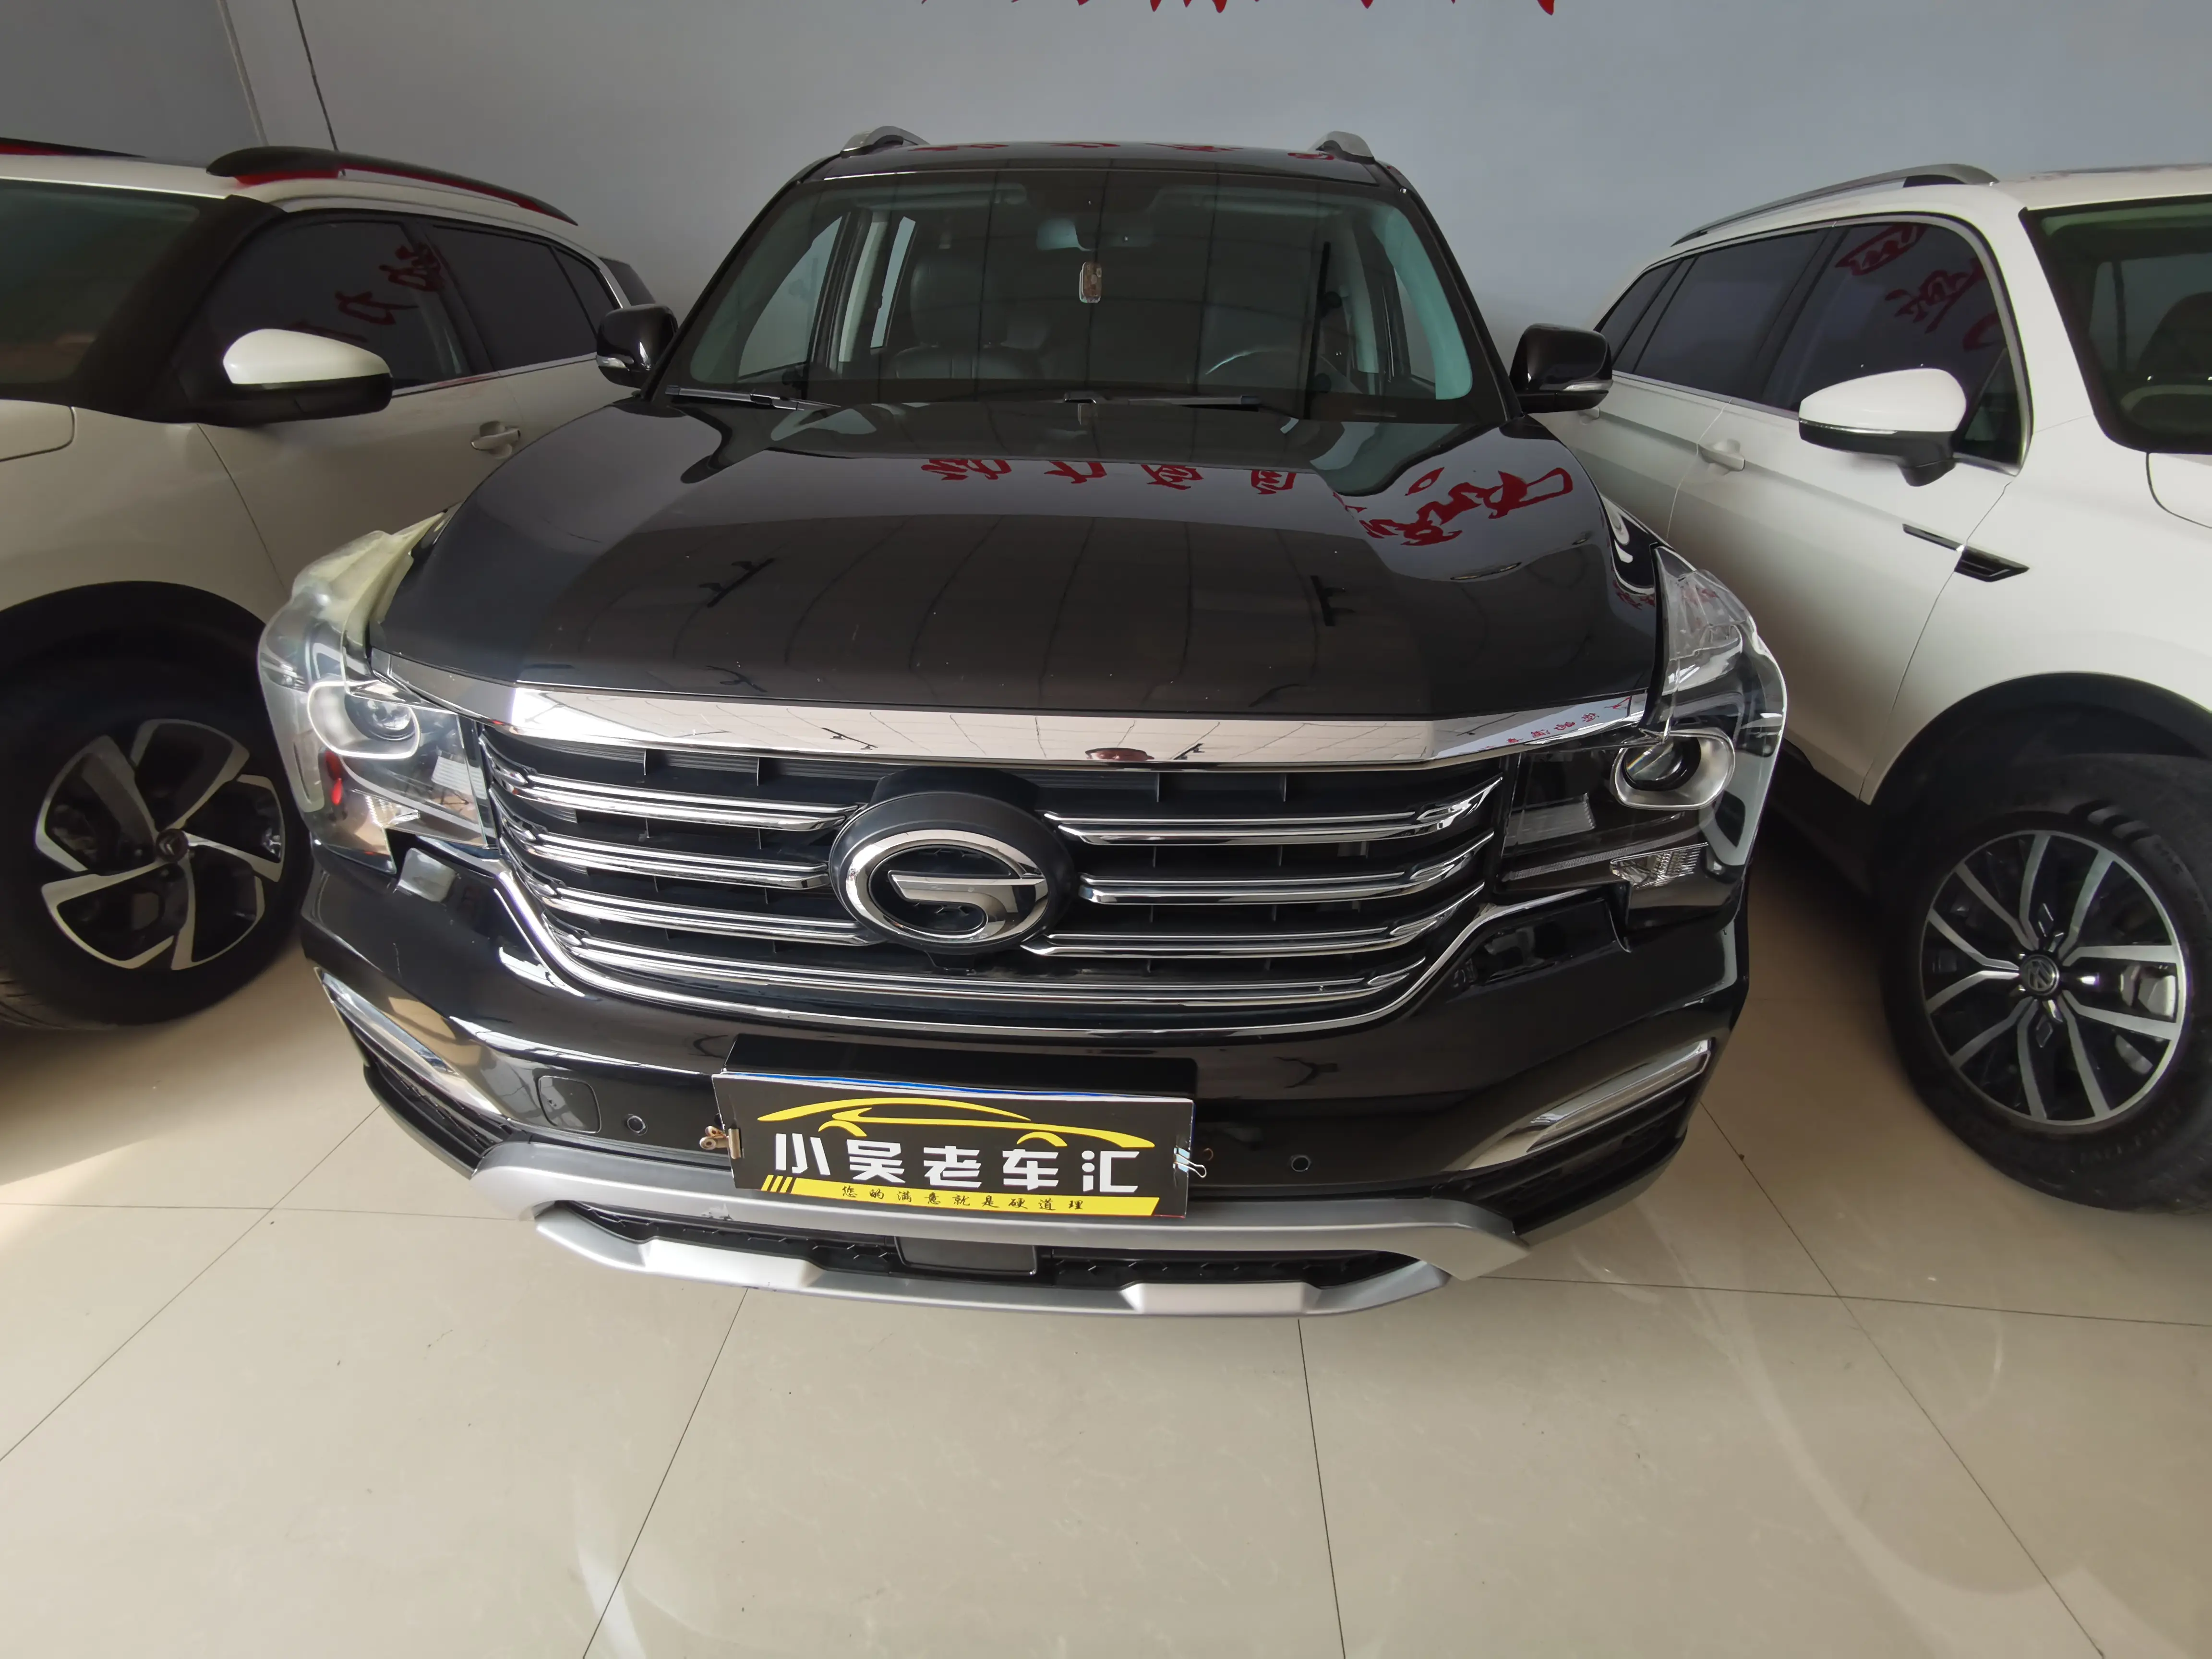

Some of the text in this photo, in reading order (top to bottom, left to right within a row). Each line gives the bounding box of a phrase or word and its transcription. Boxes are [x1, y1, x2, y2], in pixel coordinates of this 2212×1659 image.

[775, 1133, 1140, 1193] 小吴老车汇
[842, 1185, 1083, 1211] 您的满意就是硬道理
